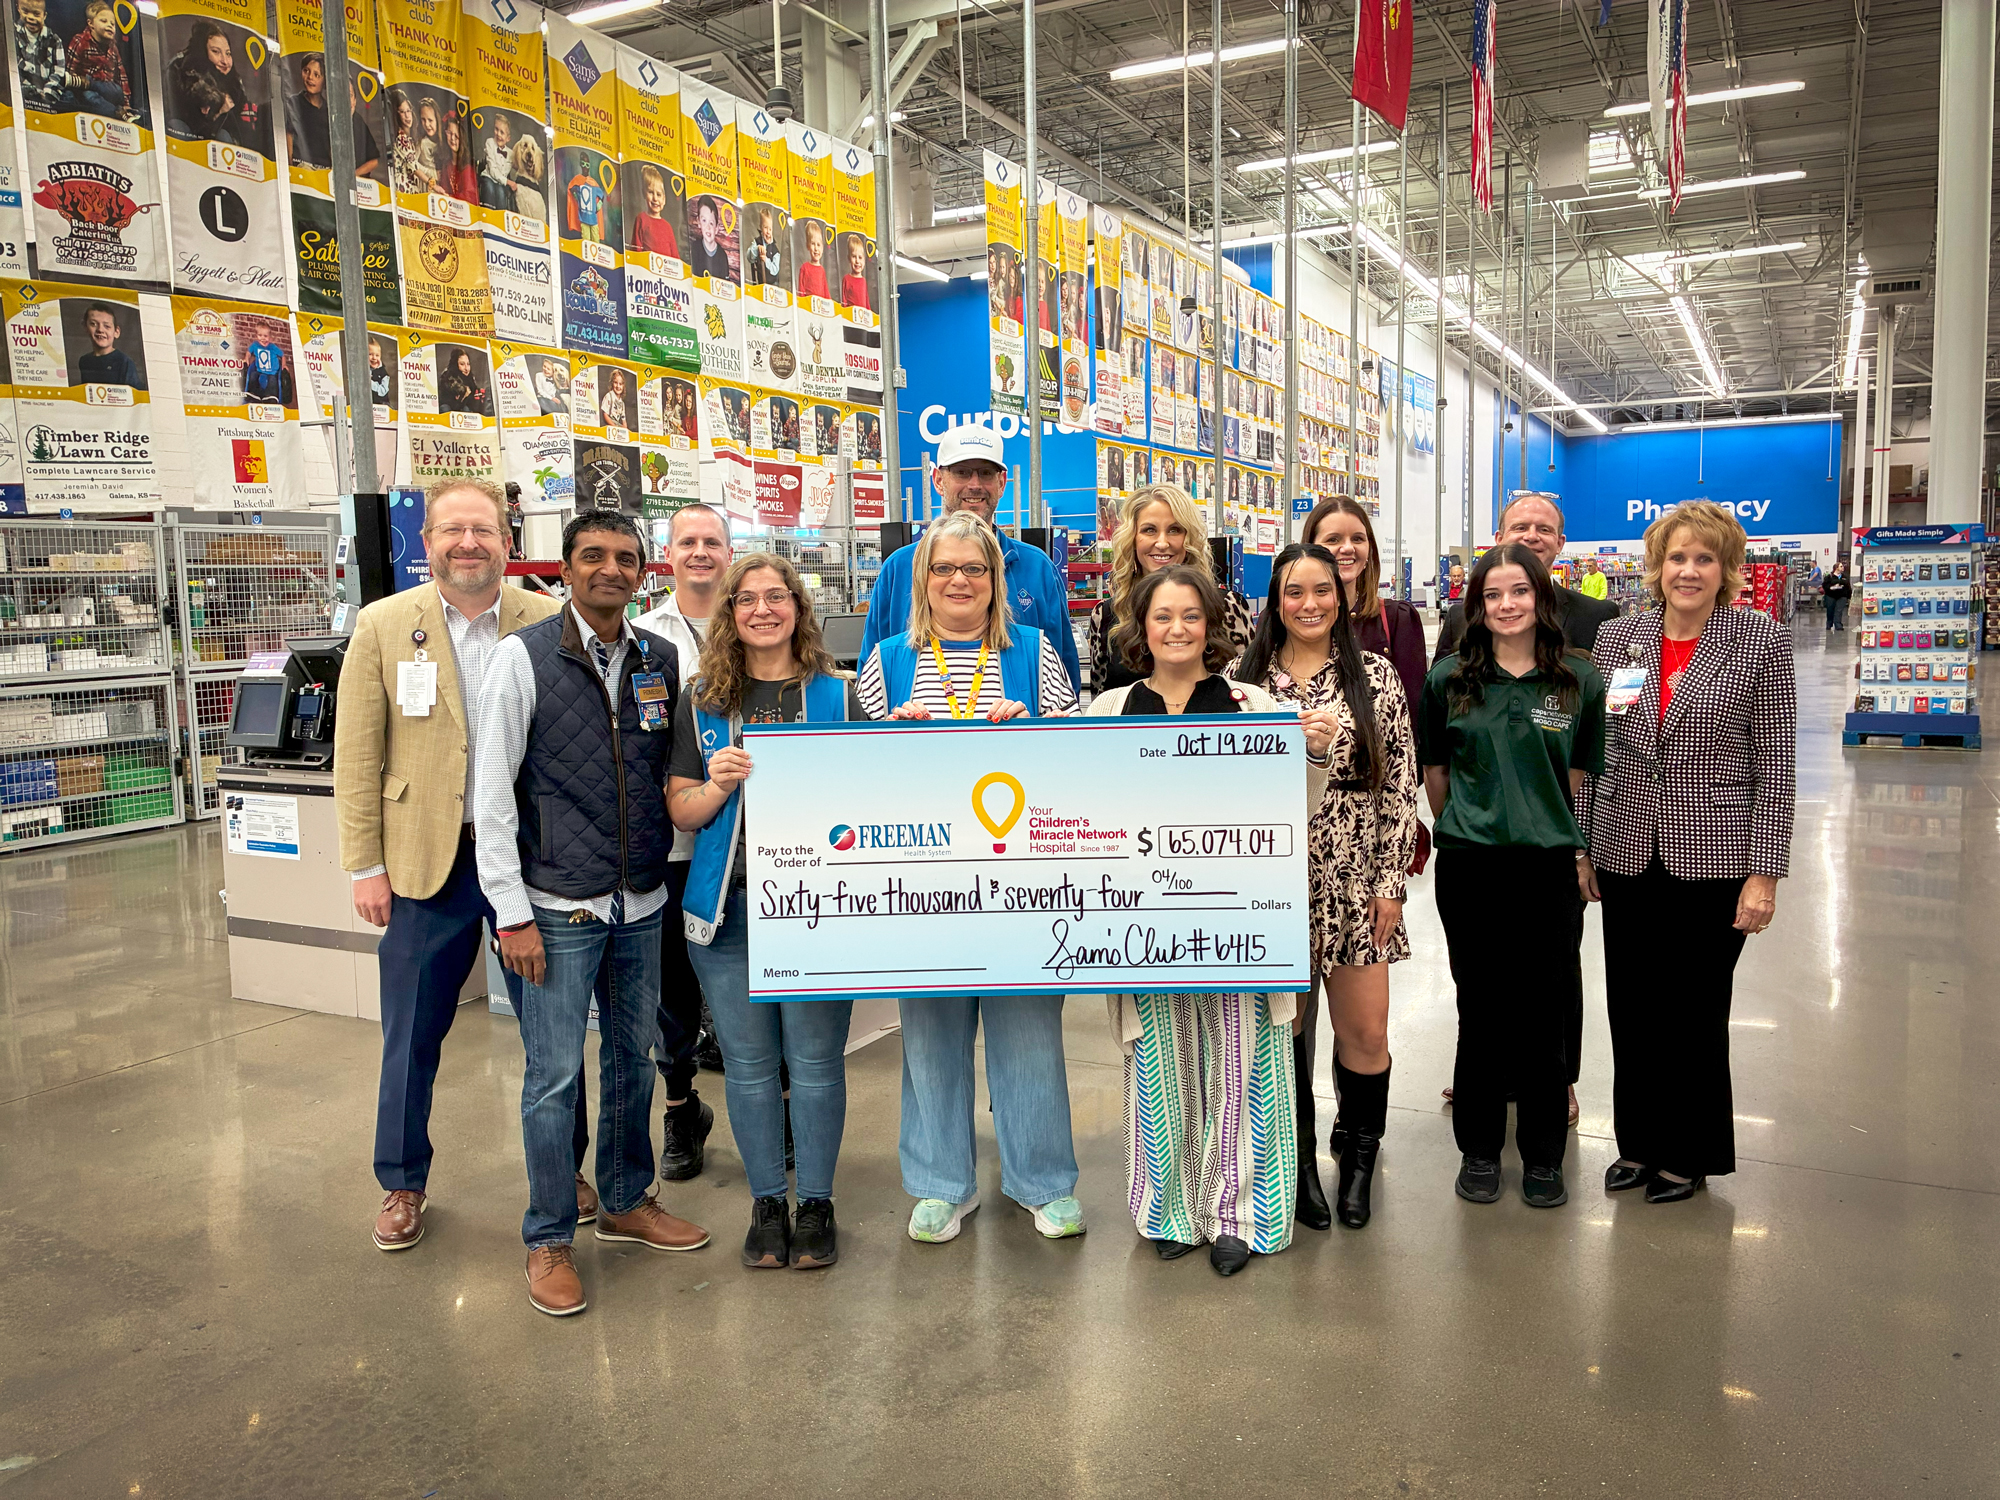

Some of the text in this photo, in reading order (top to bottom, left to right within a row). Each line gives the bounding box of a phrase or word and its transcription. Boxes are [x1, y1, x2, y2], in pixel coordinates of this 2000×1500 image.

[288, 14, 318, 31] ISAAC
[409, 8, 433, 25] club
[387, 20, 457, 53] THANK YOU
[491, 24, 520, 42] sam's
[494, 37, 517, 55] club
[409, 54, 464, 77] REAGAN ADDISON
[477, 48, 538, 83] THANK YOU
[569, 55, 596, 81] Sam's
[496, 82, 518, 97] ZANE
[638, 87, 660, 104] sam's
[553, 91, 612, 125] THANK YOU
[641, 100, 658, 114] club
[569, 119, 601, 139] ELIJAH
[626, 109, 674, 139] THANK YOU
[697, 112, 720, 136] Sam's
[638, 136, 664, 153] VINCENT
[754, 136, 772, 149] sam's
[686, 143, 732, 169] THANK YOU
[757, 148, 770, 160] club
[802, 155, 818, 167] sam's
[692, 164, 728, 187] MADDOX
[743, 158, 782, 180] THANK YOU
[805, 166, 817, 176] club
[50, 162, 131, 192] ABBIATTI'S
[792, 175, 815, 191] THANK
[846, 171, 861, 183] sam's
[755, 181, 775, 193] PAXTON
[847, 182, 860, 192] club
[837, 191, 857, 206] THANK
[988, 203, 1006, 217] THANK
[72, 219, 119, 234] Back Door
[72, 229, 112, 242] Catering
[52, 236, 137, 255] Call 417-359-8579
[57, 248, 135, 264] Or 417-359-6579
[486, 250, 534, 275] IDGELINE
[177, 251, 284, 288] Leggett & Platt
[307, 270, 398, 290] AIR CO.
[490, 286, 546, 307] 417.529.2419
[627, 275, 690, 305] Hometown
[20, 302, 40, 311] sam's
[564, 289, 617, 319] KONA ICE
[23, 310, 39, 318] club
[631, 303, 689, 323] PEDIATRICS
[11, 324, 52, 337] THANK
[565, 323, 622, 345] 417.434.1449
[13, 336, 38, 348] YOU
[631, 330, 694, 349] 417-626-7337
[698, 342, 740, 361] ISSOURI
[747, 340, 769, 354] BONES
[182, 356, 243, 370] THANK YOU
[304, 351, 333, 362] THANK
[700, 354, 741, 372] OUTHERN
[845, 352, 879, 371] ROSSLAND
[403, 362, 431, 373] THANK
[816, 365, 846, 378] DENTAL
[201, 377, 231, 388] ZANE
[404, 372, 421, 381] YOU
[498, 372, 525, 382] THANK
[813, 376, 838, 384] JOPLIN
[499, 381, 518, 390] YOU
[575, 380, 595, 390] THANK
[576, 389, 587, 398] YOU
[640, 390, 658, 399] THANK
[640, 398, 653, 407] YOU
[40, 430, 150, 446] Timber Ridge
[218, 427, 275, 438] Pittsburg State
[60, 446, 149, 459] Lawn Care
[412, 438, 490, 454] El Vallarta
[523, 441, 558, 450] DIAMOND
[26, 466, 70, 476] Complete
[74, 467, 118, 475] Lawncare
[669, 461, 689, 469] Pediatric
[669, 470, 692, 478] Associates
[754, 473, 777, 485] WINES
[109, 492, 137, 500] Galena,
[232, 485, 273, 494] Women's
[756, 487, 780, 498] SPIRITS
[234, 499, 275, 509] Basketball
[757, 500, 784, 511] SMOKES
[1297, 501, 1309, 510] Z3
[1627, 499, 1771, 522] Phaacy
[1876, 530, 1894, 538] Gifts
[1917, 529, 1944, 538] Simple
[1553, 721, 1569, 729] CAPS
[1177, 733, 1211, 756] Oct
[1140, 747, 1167, 758] Date
[1028, 806, 1053, 816] Your
[1029, 817, 1090, 828] Children's
[858, 823, 952, 849] FREEMAN
[1029, 829, 1128, 840] Miracle Network
[1029, 841, 1076, 855] Hospital
[1137, 827, 1153, 857] $
[757, 845, 814, 858] Pay to the
[928, 849, 952, 858] System
[774, 857, 822, 868] Order of
[760, 879, 877, 929] Sixty-five
[882, 874, 983, 915] thousand
[1251, 900, 1292, 910] Dollars
[1045, 918, 1122, 980] Sam's
[763, 967, 800, 978] Memo
